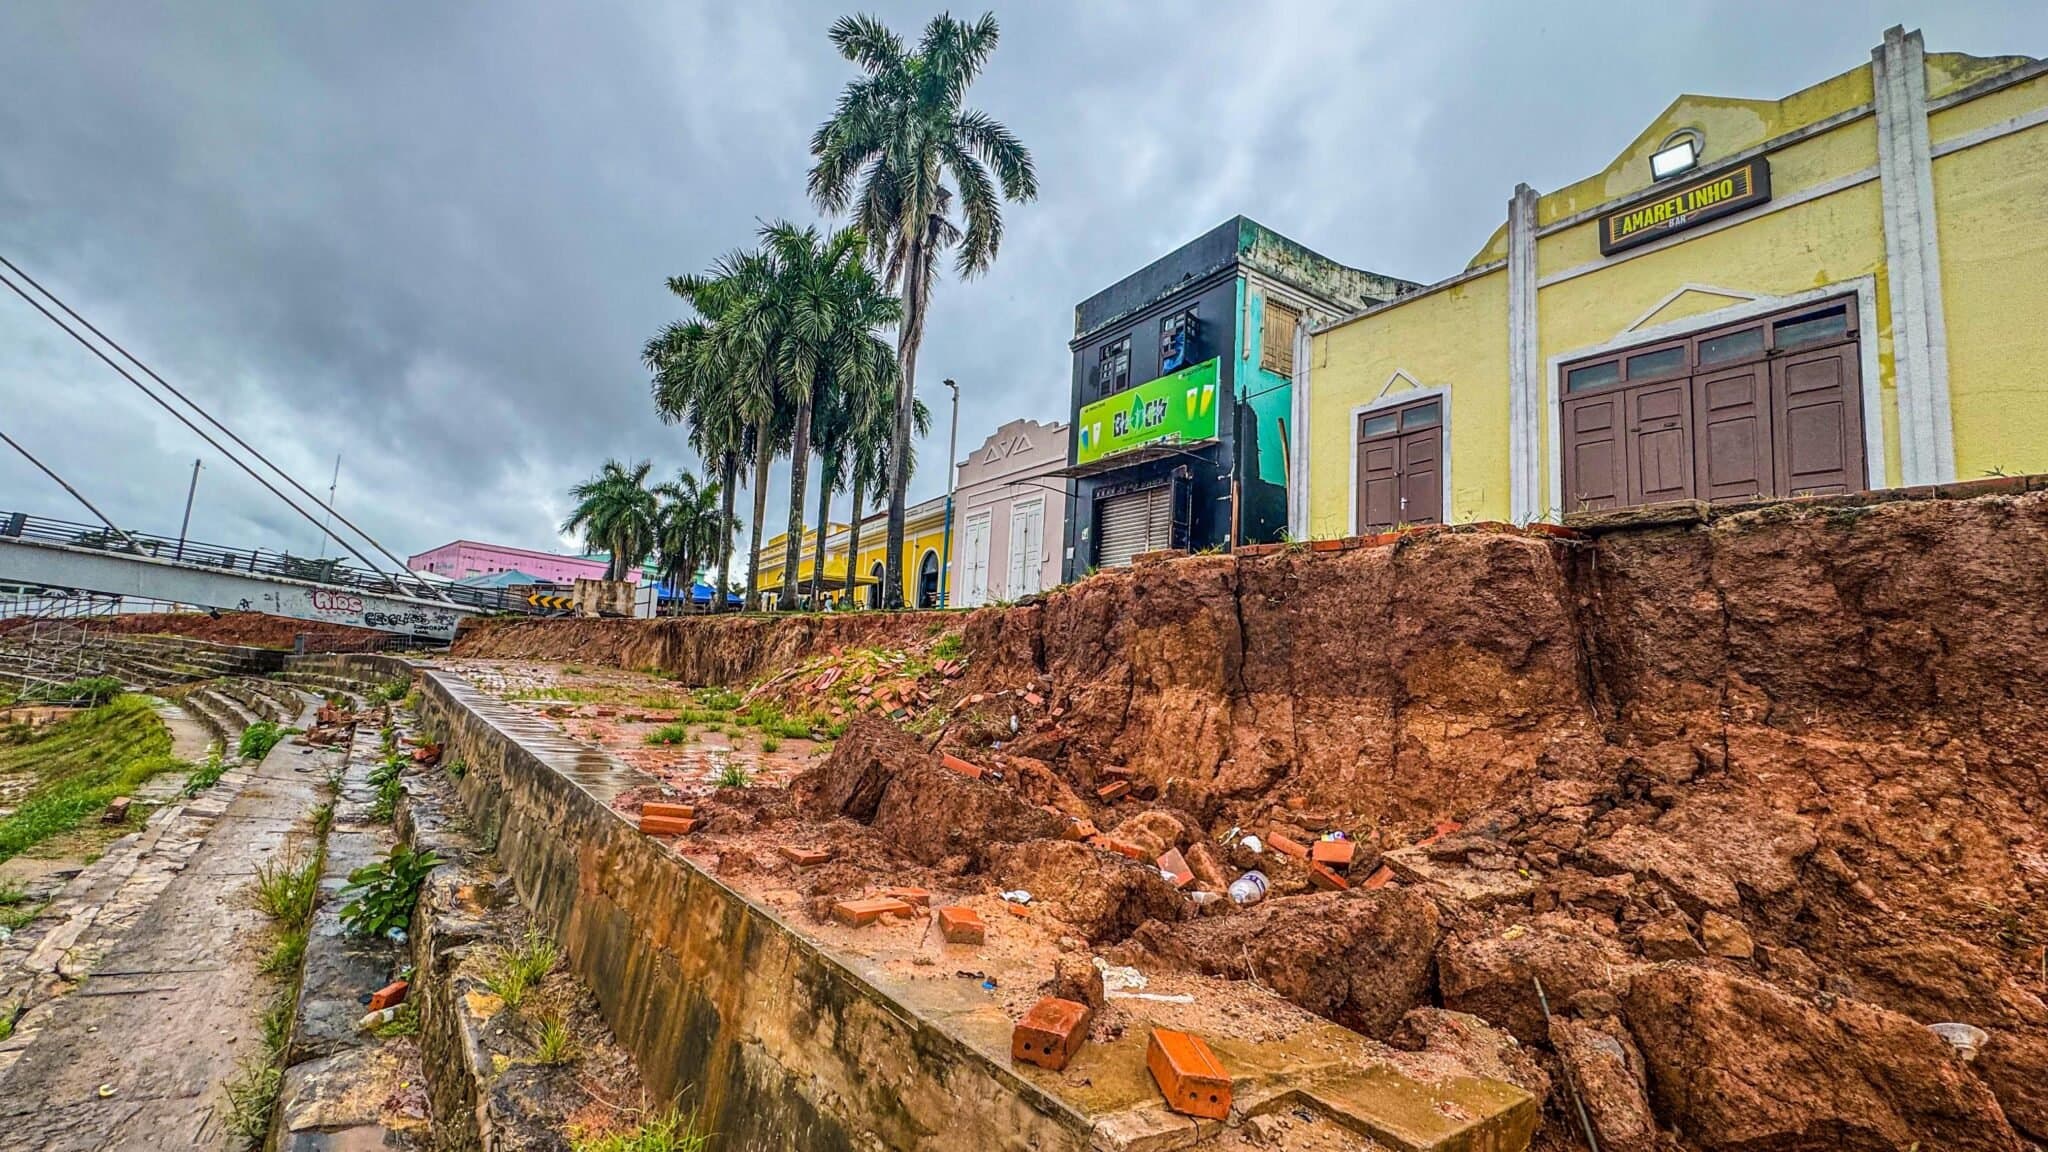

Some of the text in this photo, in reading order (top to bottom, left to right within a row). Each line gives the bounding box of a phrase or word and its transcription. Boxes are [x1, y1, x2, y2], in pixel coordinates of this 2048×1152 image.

[1622, 179, 1733, 234] AMARELINHO
[1668, 214, 1687, 228] BAR
[1113, 393, 1168, 437] BLCK
